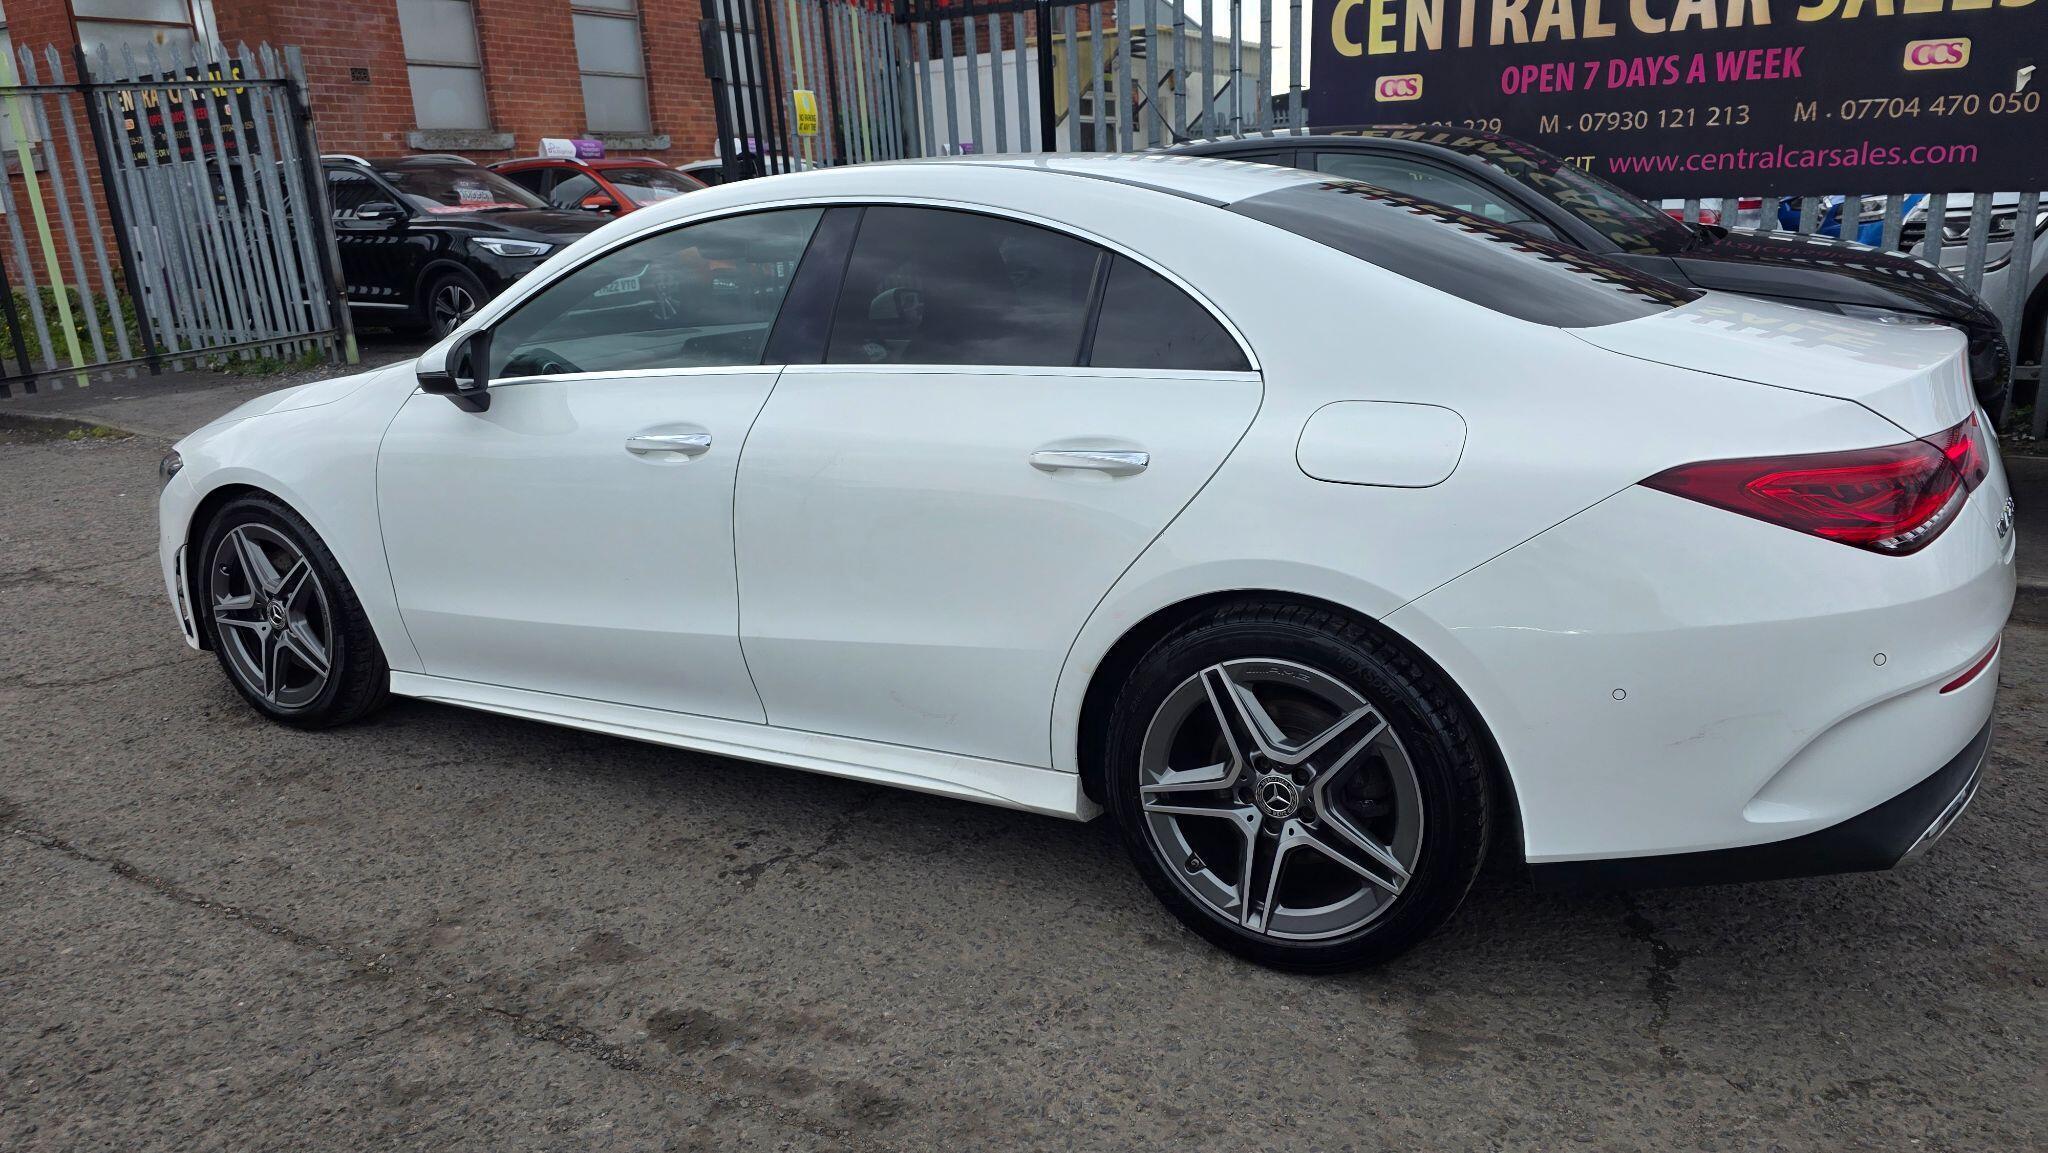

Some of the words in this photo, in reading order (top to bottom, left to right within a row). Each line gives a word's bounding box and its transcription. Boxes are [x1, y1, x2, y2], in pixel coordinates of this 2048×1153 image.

[1331, 0, 1616, 57] CENTRAL
[1501, 61, 1575, 95] OPEN
[1583, 61, 1601, 89] 7
[1608, 55, 1680, 89] DAYS
[1686, 52, 1706, 84] A
[1716, 46, 1804, 82] WEEK
[1539, 114, 1559, 134] M
[1579, 110, 1648, 132] 07930
[1658, 108, 1695, 128] 121
[1706, 105, 1750, 127] 213
[1794, 101, 1817, 122] M
[1840, 97, 1920, 120] 07704
[1928, 94, 1980, 117] 470
[1989, 91, 2041, 114] 050
[1608, 141, 1978, 173] www.centralcarsales.com
